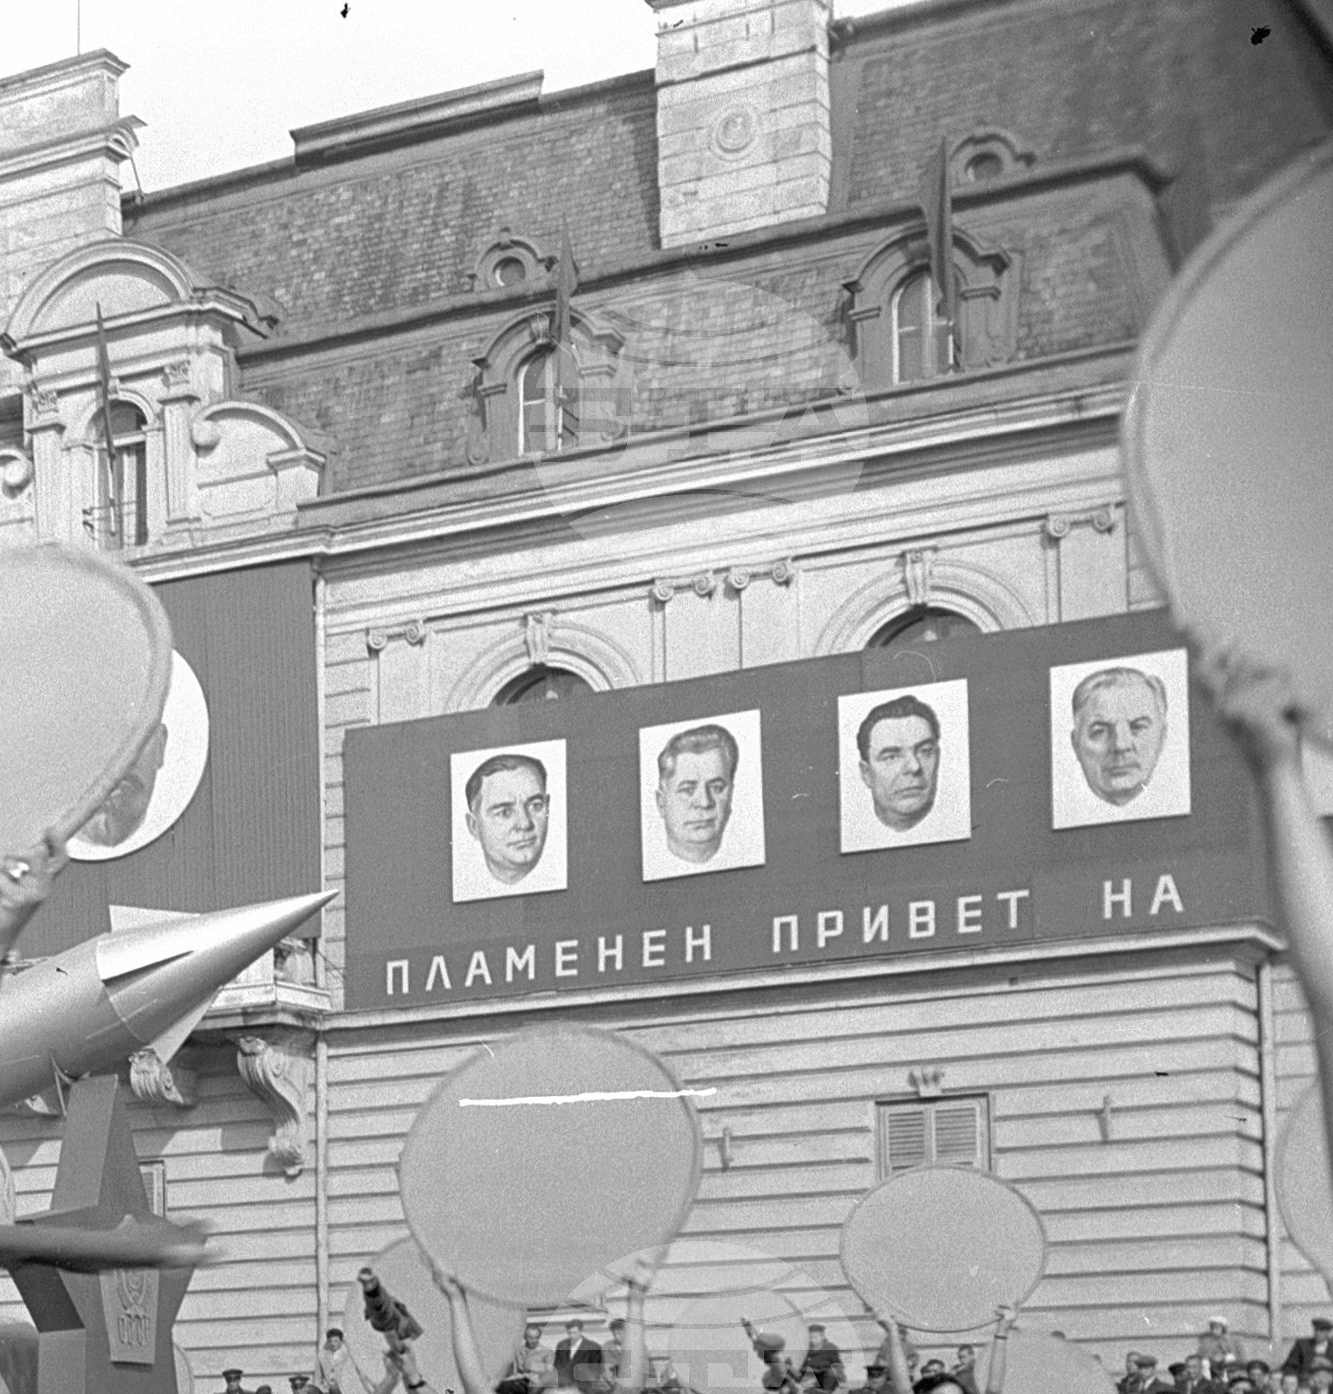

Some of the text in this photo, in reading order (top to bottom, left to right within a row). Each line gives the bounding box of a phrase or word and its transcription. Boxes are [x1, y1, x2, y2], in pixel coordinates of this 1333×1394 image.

[386, 874, 1185, 996] ПЛАМЕНЕН ПРИВЕТ НА
